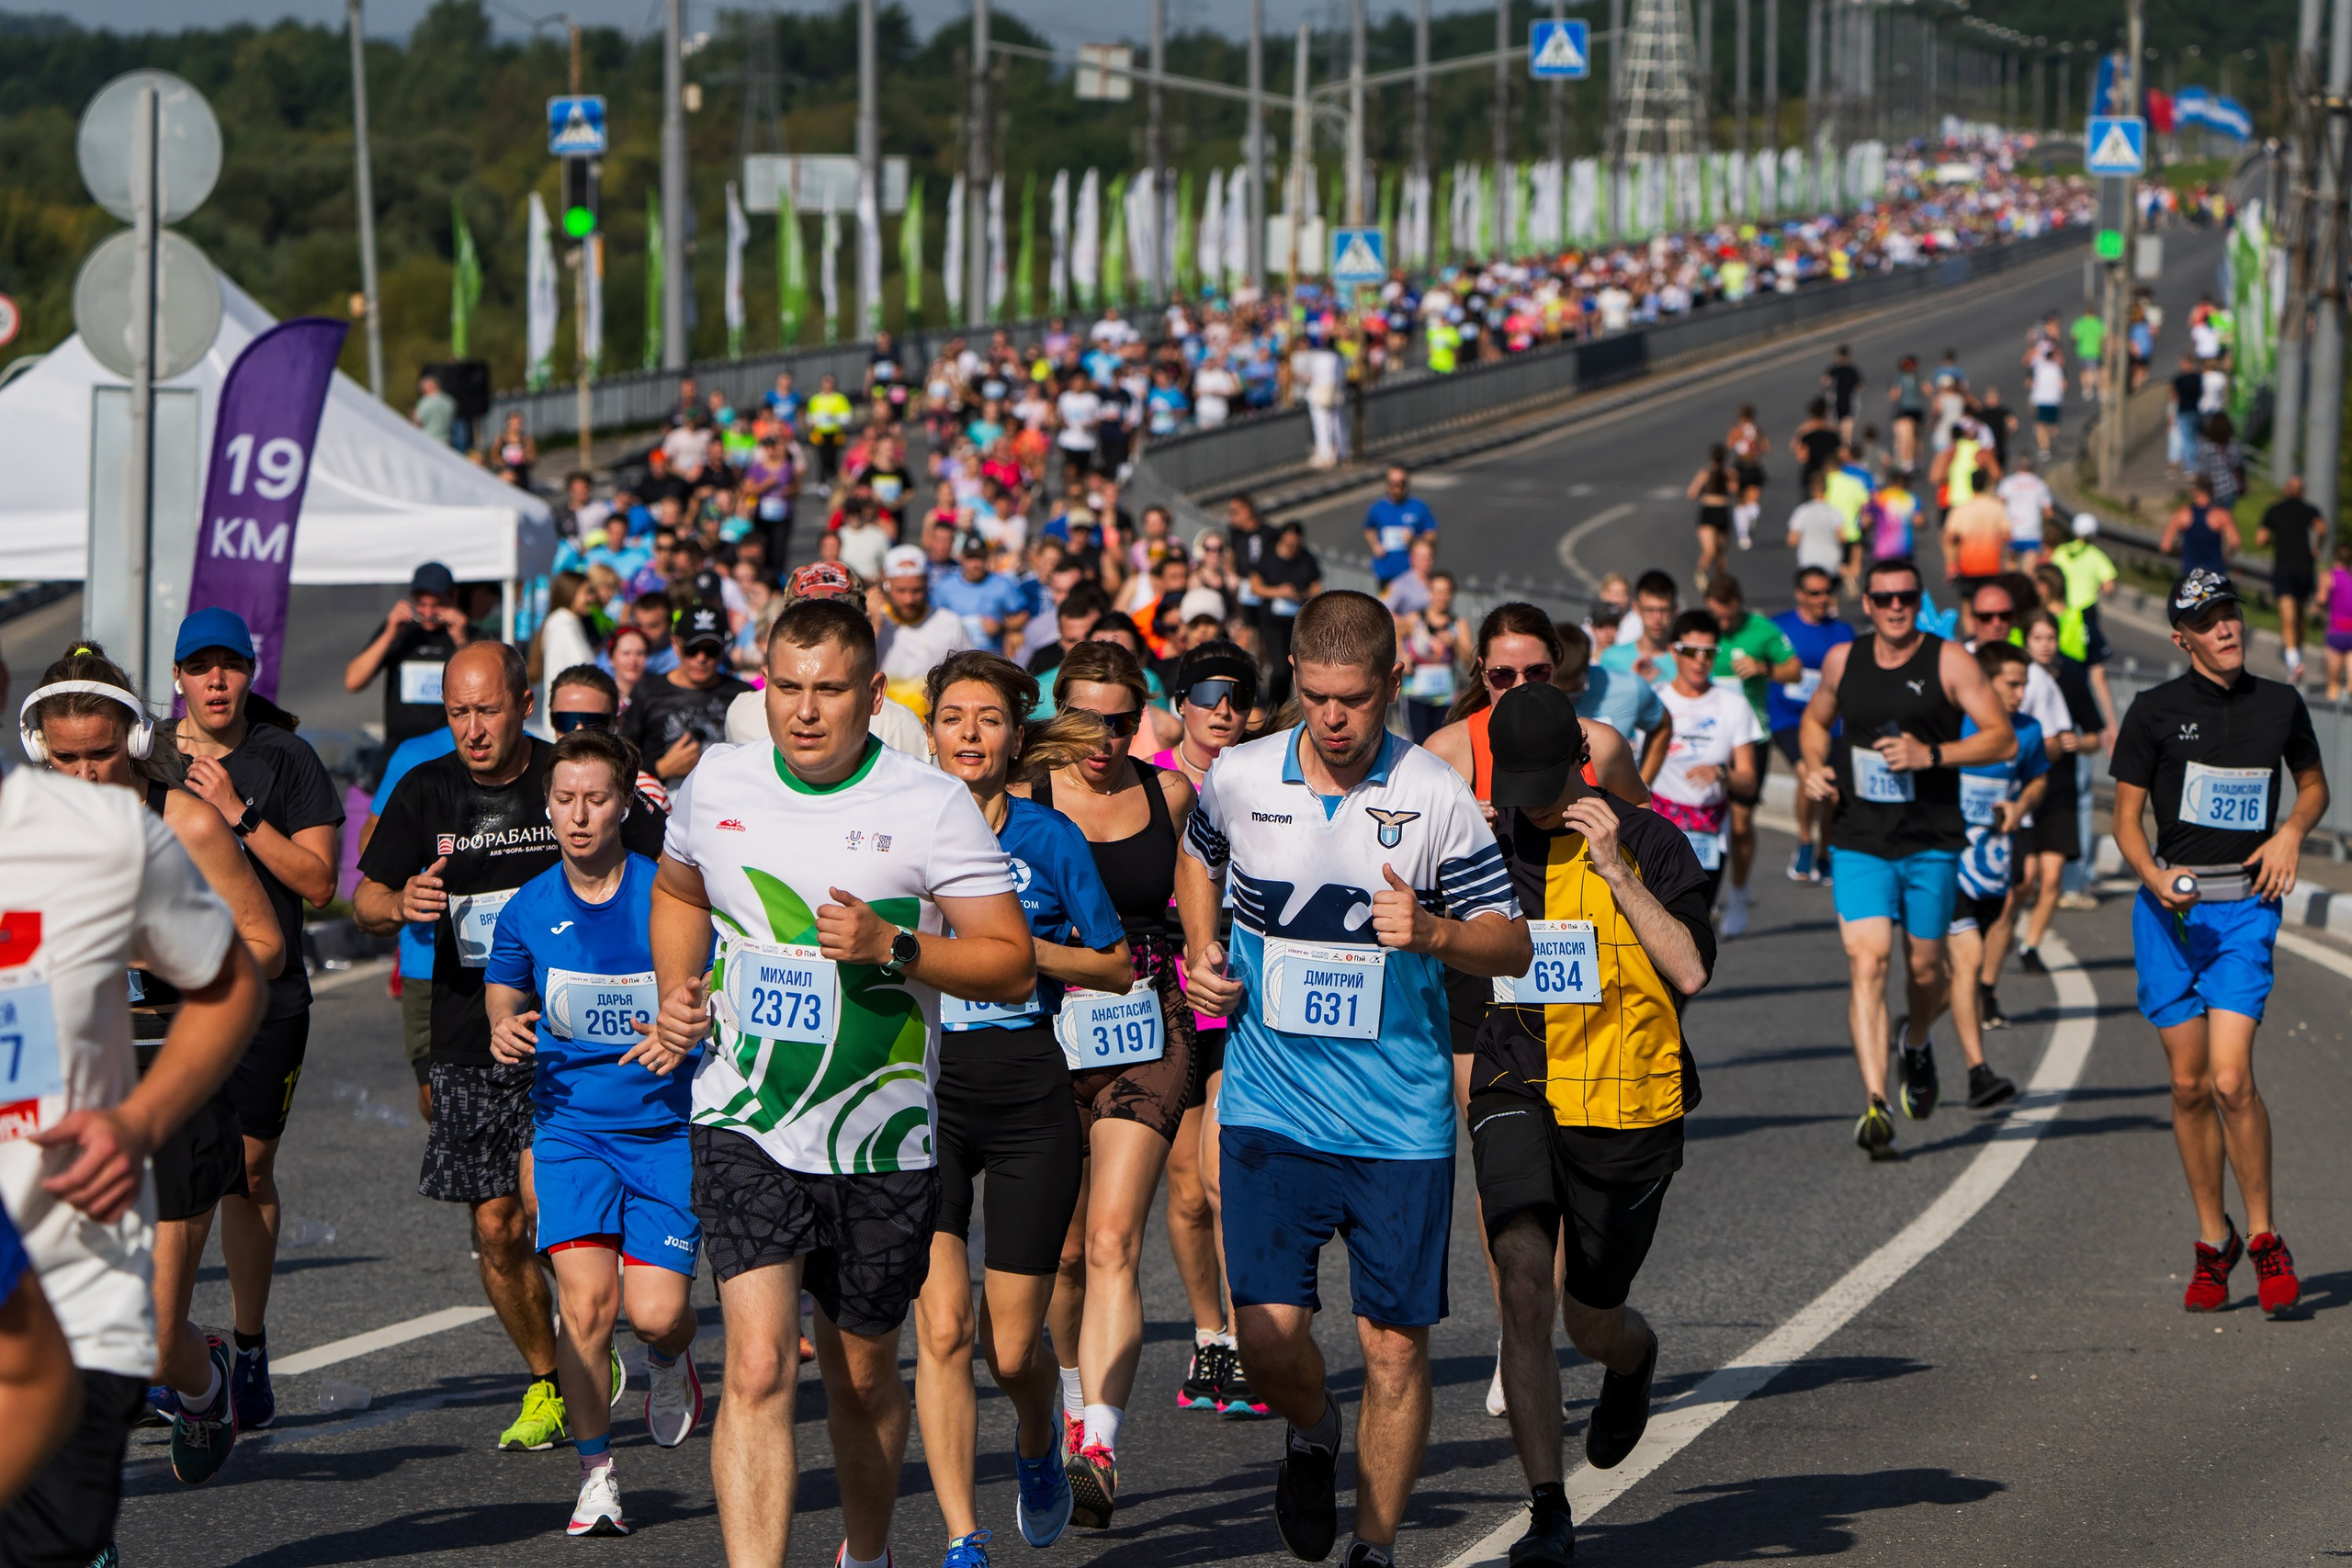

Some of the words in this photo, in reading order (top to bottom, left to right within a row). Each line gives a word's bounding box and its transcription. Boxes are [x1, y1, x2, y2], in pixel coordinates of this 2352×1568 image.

[226, 433, 305, 501] 19
[210, 516, 290, 564] КМ
[1251, 811, 1293, 825] macron
[2210, 797, 2259, 821] 3216
[456, 826, 559, 852] ФОРАБАНК
[1532, 942, 1586, 955] НАСТАСИЯ
[760, 966, 812, 987] МИХАИЛ
[1304, 969, 1364, 988] ДМИТРИЙ
[1534, 961, 1583, 993] 634
[597, 993, 633, 1006] ДАРЬЯ
[751, 987, 821, 1030] 2373
[1091, 1000, 1152, 1022] АНАСТАСИЯ
[1305, 990, 1358, 1027] 631
[585, 1009, 650, 1036] 2653
[1092, 1018, 1155, 1056] 3197
